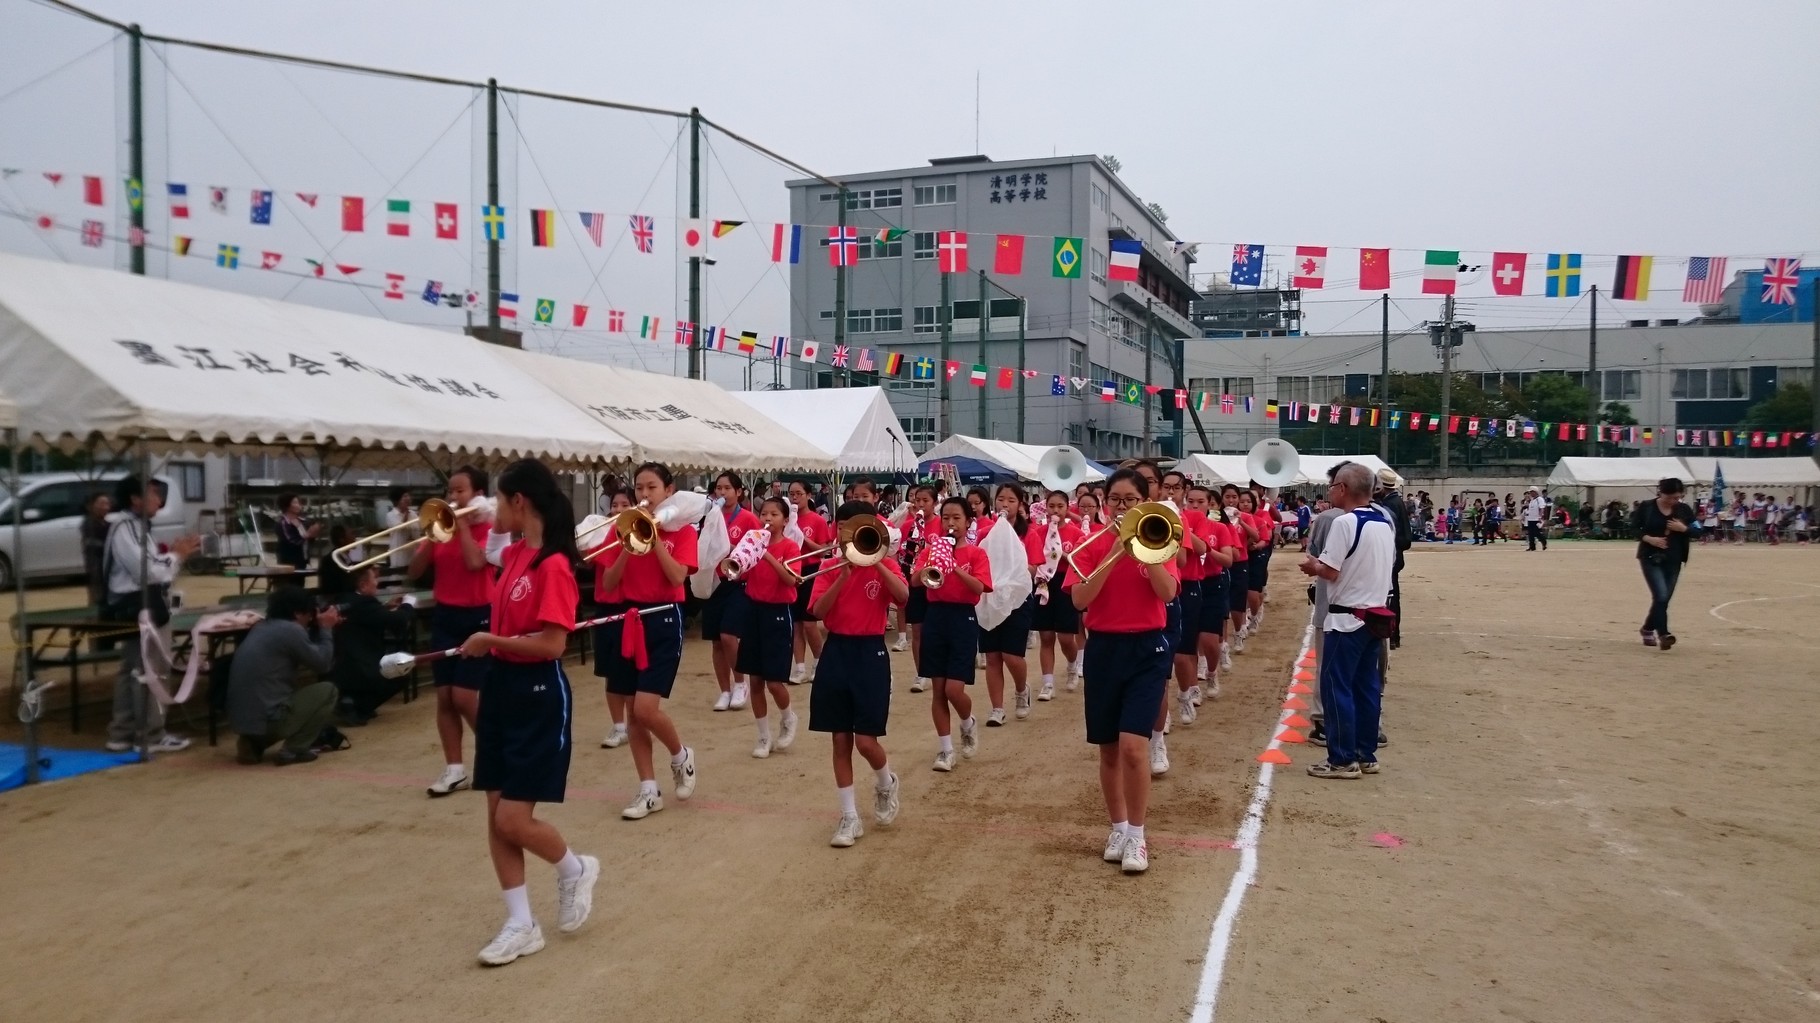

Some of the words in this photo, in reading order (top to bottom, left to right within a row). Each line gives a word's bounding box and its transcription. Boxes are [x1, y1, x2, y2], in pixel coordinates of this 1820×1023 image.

[990, 172, 1048, 188] 清明学院
[990, 187, 1047, 204] 高等学校
